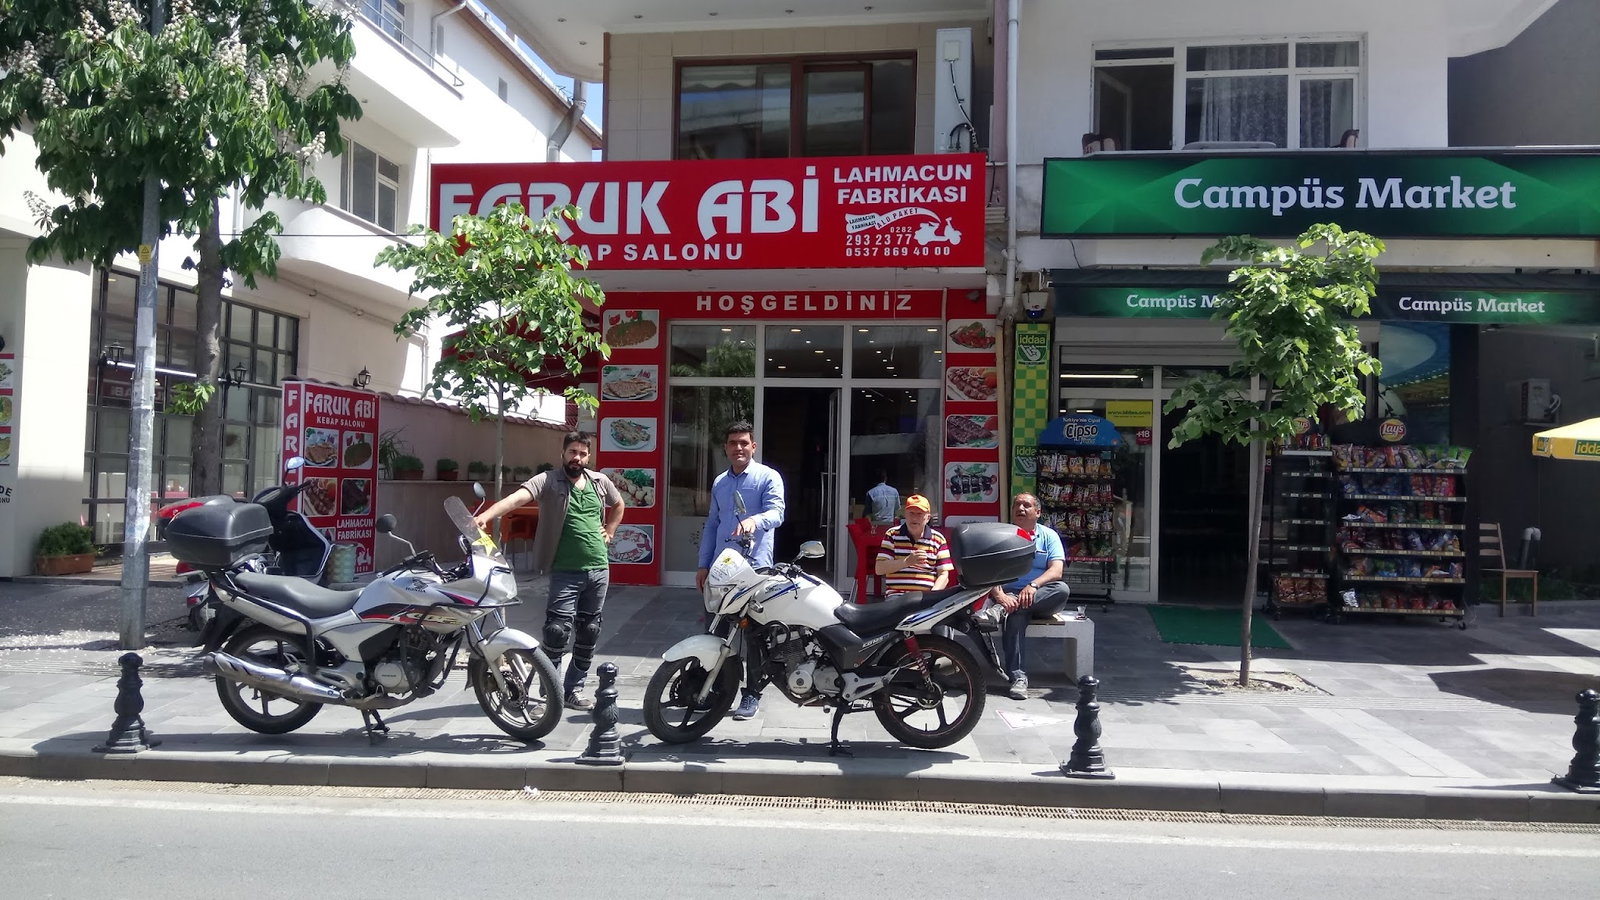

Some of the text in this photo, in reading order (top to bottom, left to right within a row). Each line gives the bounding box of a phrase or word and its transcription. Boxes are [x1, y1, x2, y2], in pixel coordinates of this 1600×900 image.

[833, 164, 972, 183] LAHMACUN
[837, 184, 967, 204] FABRİKASI
[1174, 175, 1517, 216] Campüs Market
[697, 165, 819, 241] ABİ
[892, 207, 919, 220] PAKET
[846, 233, 912, 246] 293 23 77
[623, 243, 743, 261] SALONU
[845, 246, 950, 256] 0537 869 40 00
[696, 291, 912, 315] HOŞGELDİNİZ
[1126, 294, 1197, 311] Campüs
[1398, 297, 1546, 314] Campüs Market
[1019, 334, 1046, 344] iddaa
[305, 391, 376, 419] FARUK ABİ
[316, 416, 366, 428] KEBAP SALONU
[1064, 423, 1099, 440] Cipso
[1016, 446, 1037, 456] idda
[336, 518, 374, 529] LAHMACUN
[337, 529, 372, 540] FABRİKASI
